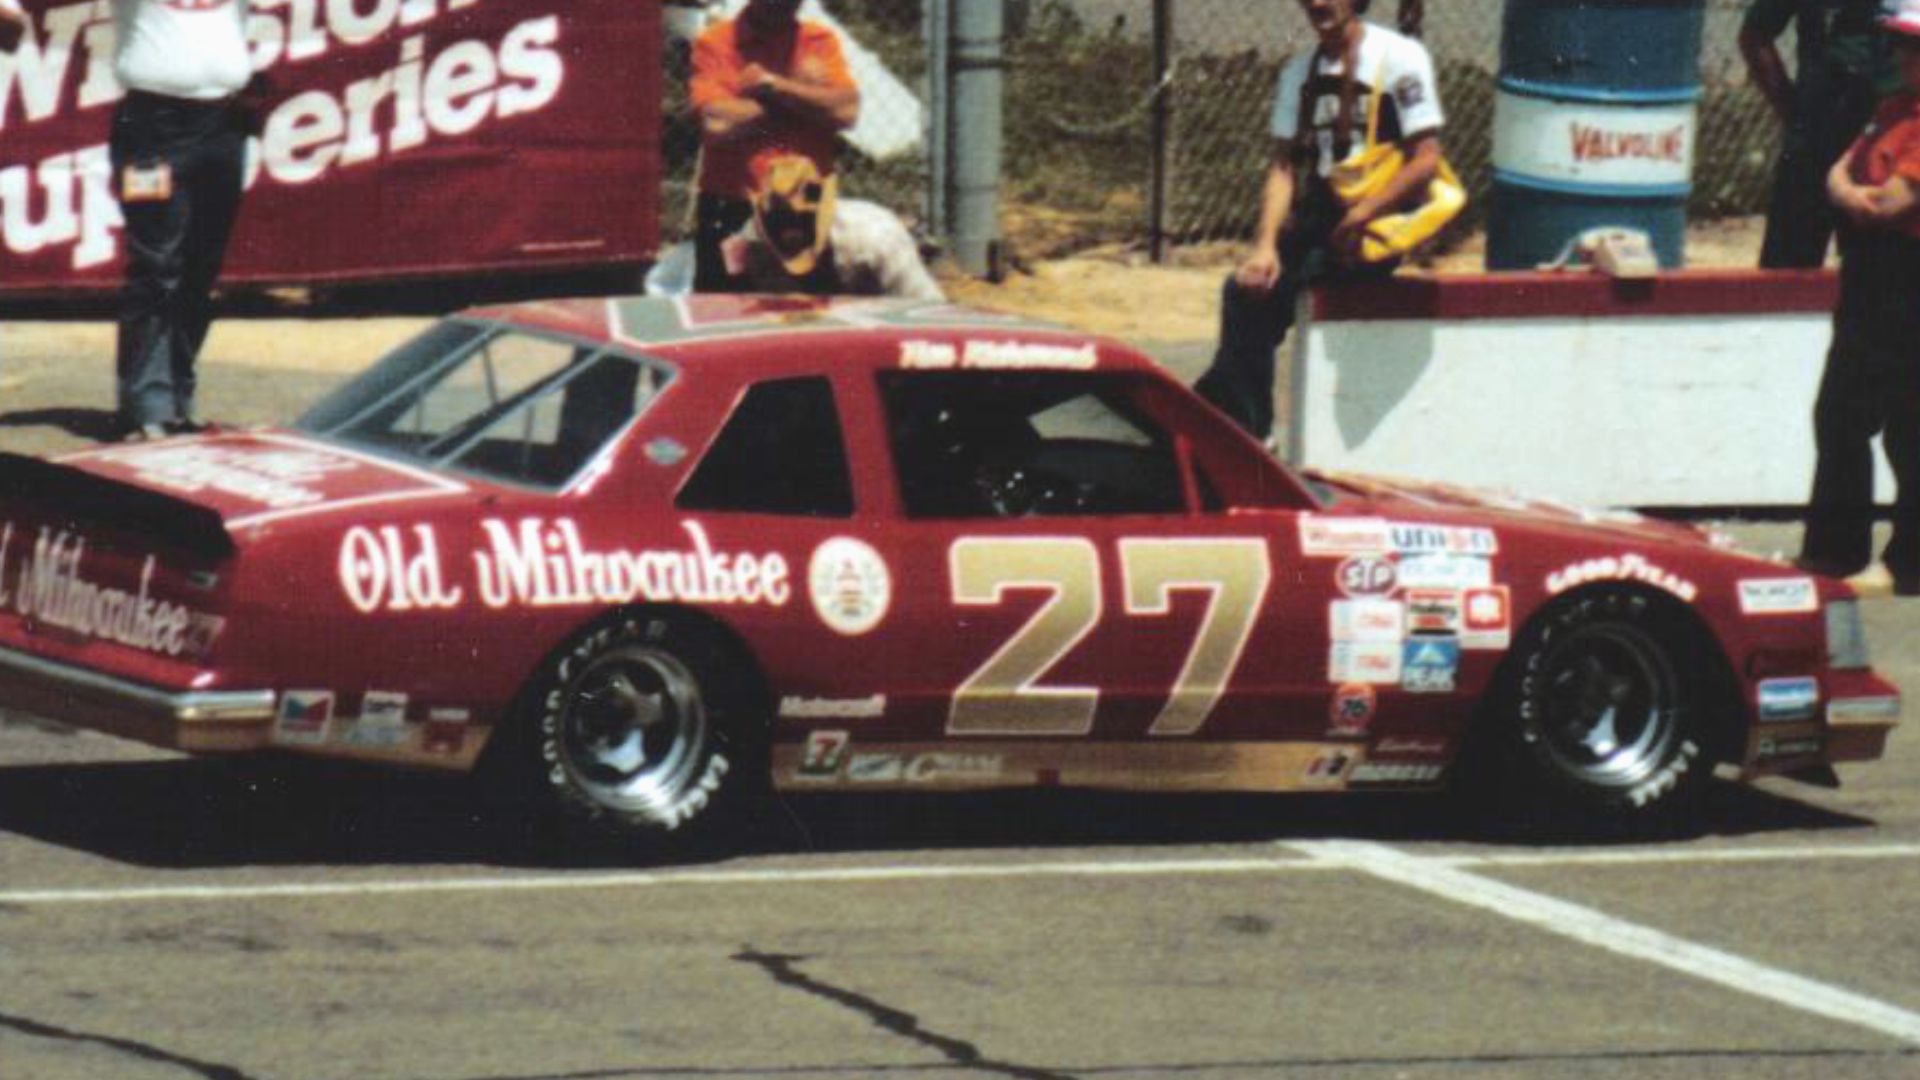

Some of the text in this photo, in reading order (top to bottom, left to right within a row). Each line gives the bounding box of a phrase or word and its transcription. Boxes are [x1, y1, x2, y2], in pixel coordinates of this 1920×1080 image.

[242, 15, 563, 191] eries
[1569, 120, 1684, 162] VALVOLINE
[338, 517, 791, 613] Old Milwaukee
[1342, 559, 1395, 591] STP
[944, 535, 1272, 736] 27
